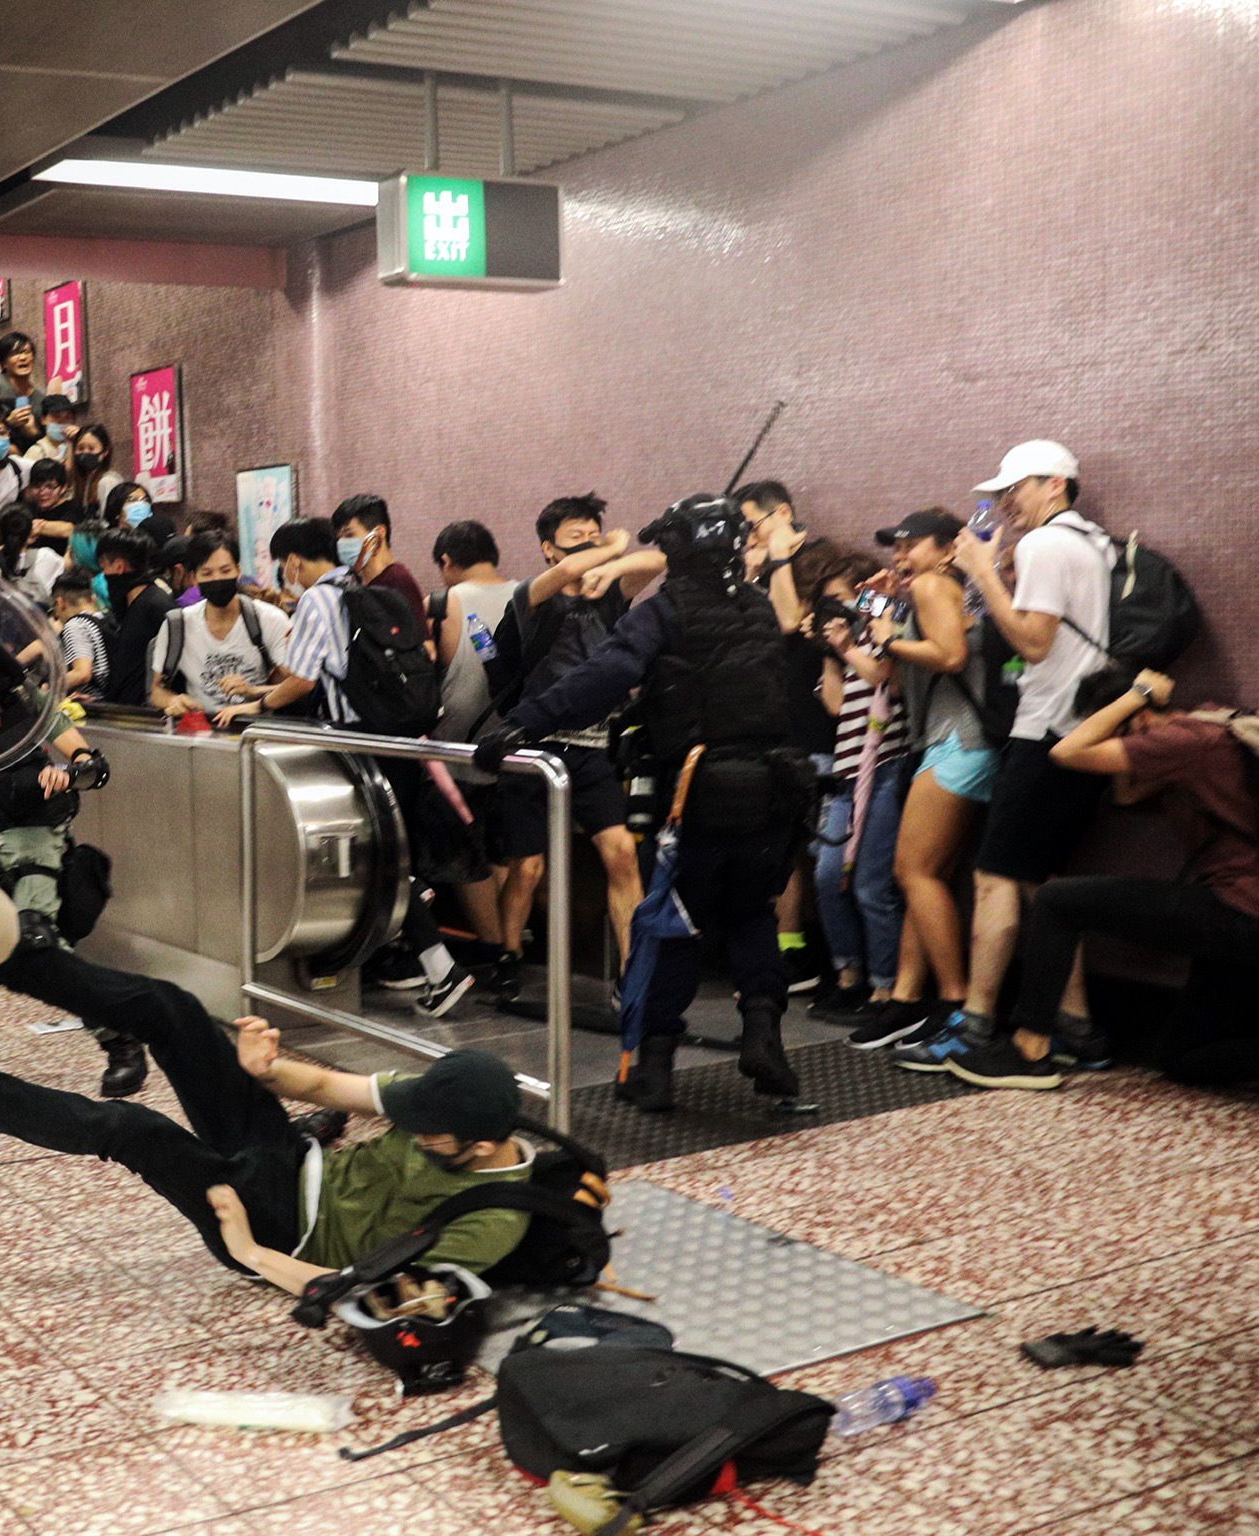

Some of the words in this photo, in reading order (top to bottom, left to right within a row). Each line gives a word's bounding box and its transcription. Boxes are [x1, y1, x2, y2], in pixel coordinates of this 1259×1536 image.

[424, 240, 470, 262] EXIT
[52, 300, 79, 378] 月
[136, 390, 173, 472] 餅
